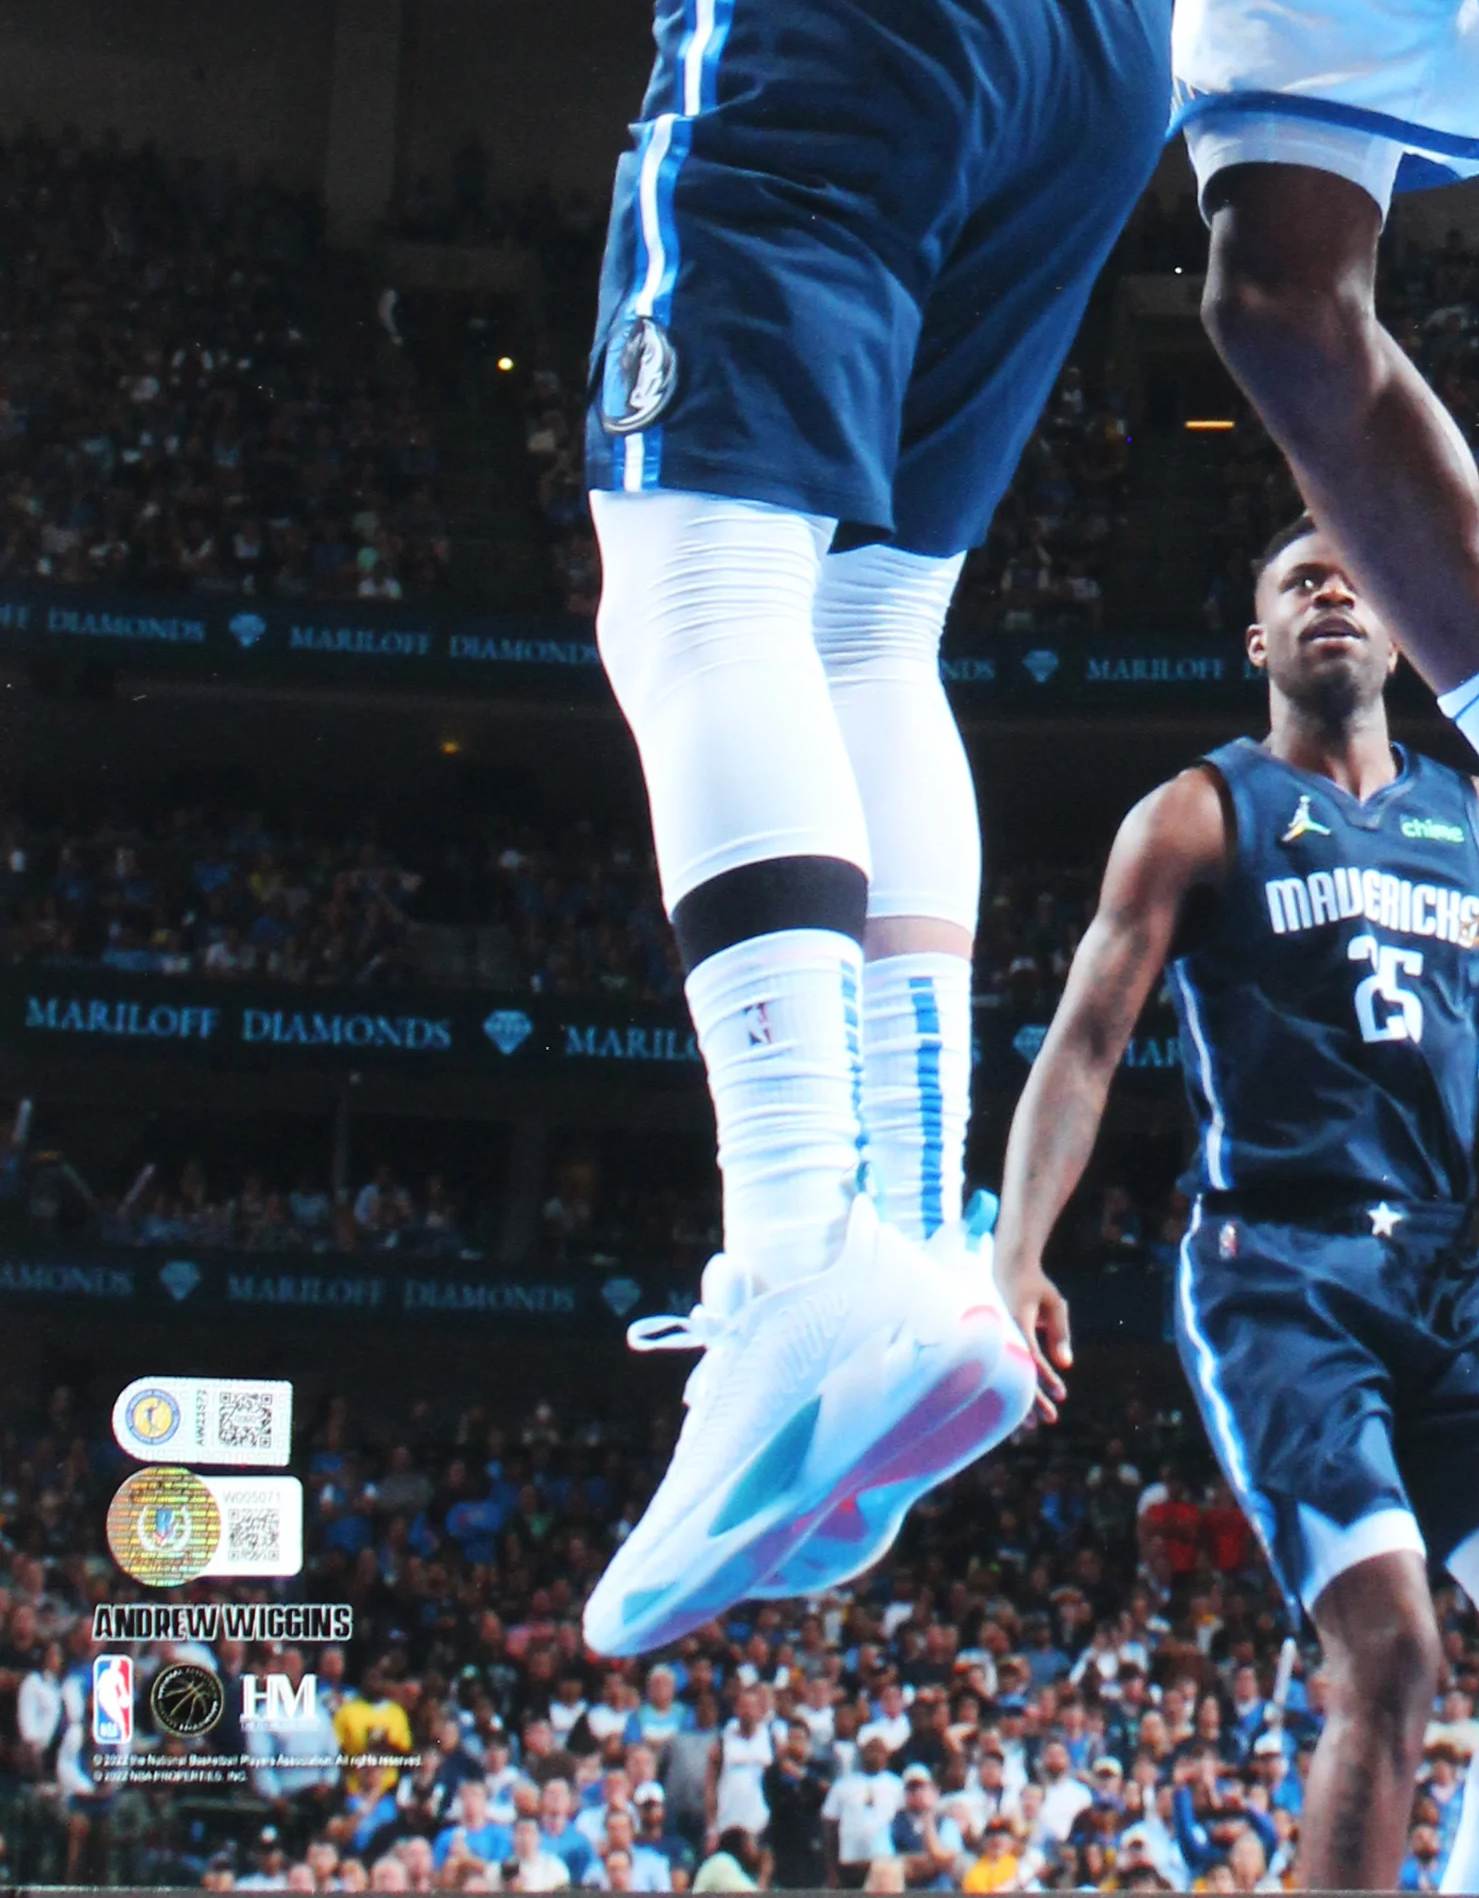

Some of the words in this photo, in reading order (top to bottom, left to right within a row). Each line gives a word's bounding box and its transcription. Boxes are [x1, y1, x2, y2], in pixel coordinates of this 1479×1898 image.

[48, 606, 207, 643] DIAMONDS
[289, 625, 432, 655] MARILOFF
[1402, 817, 1464, 844] chime
[1347, 934, 1424, 1044] 25
[26, 996, 220, 1040] MARILOFF
[242, 1007, 452, 1052] DIAMONDS
